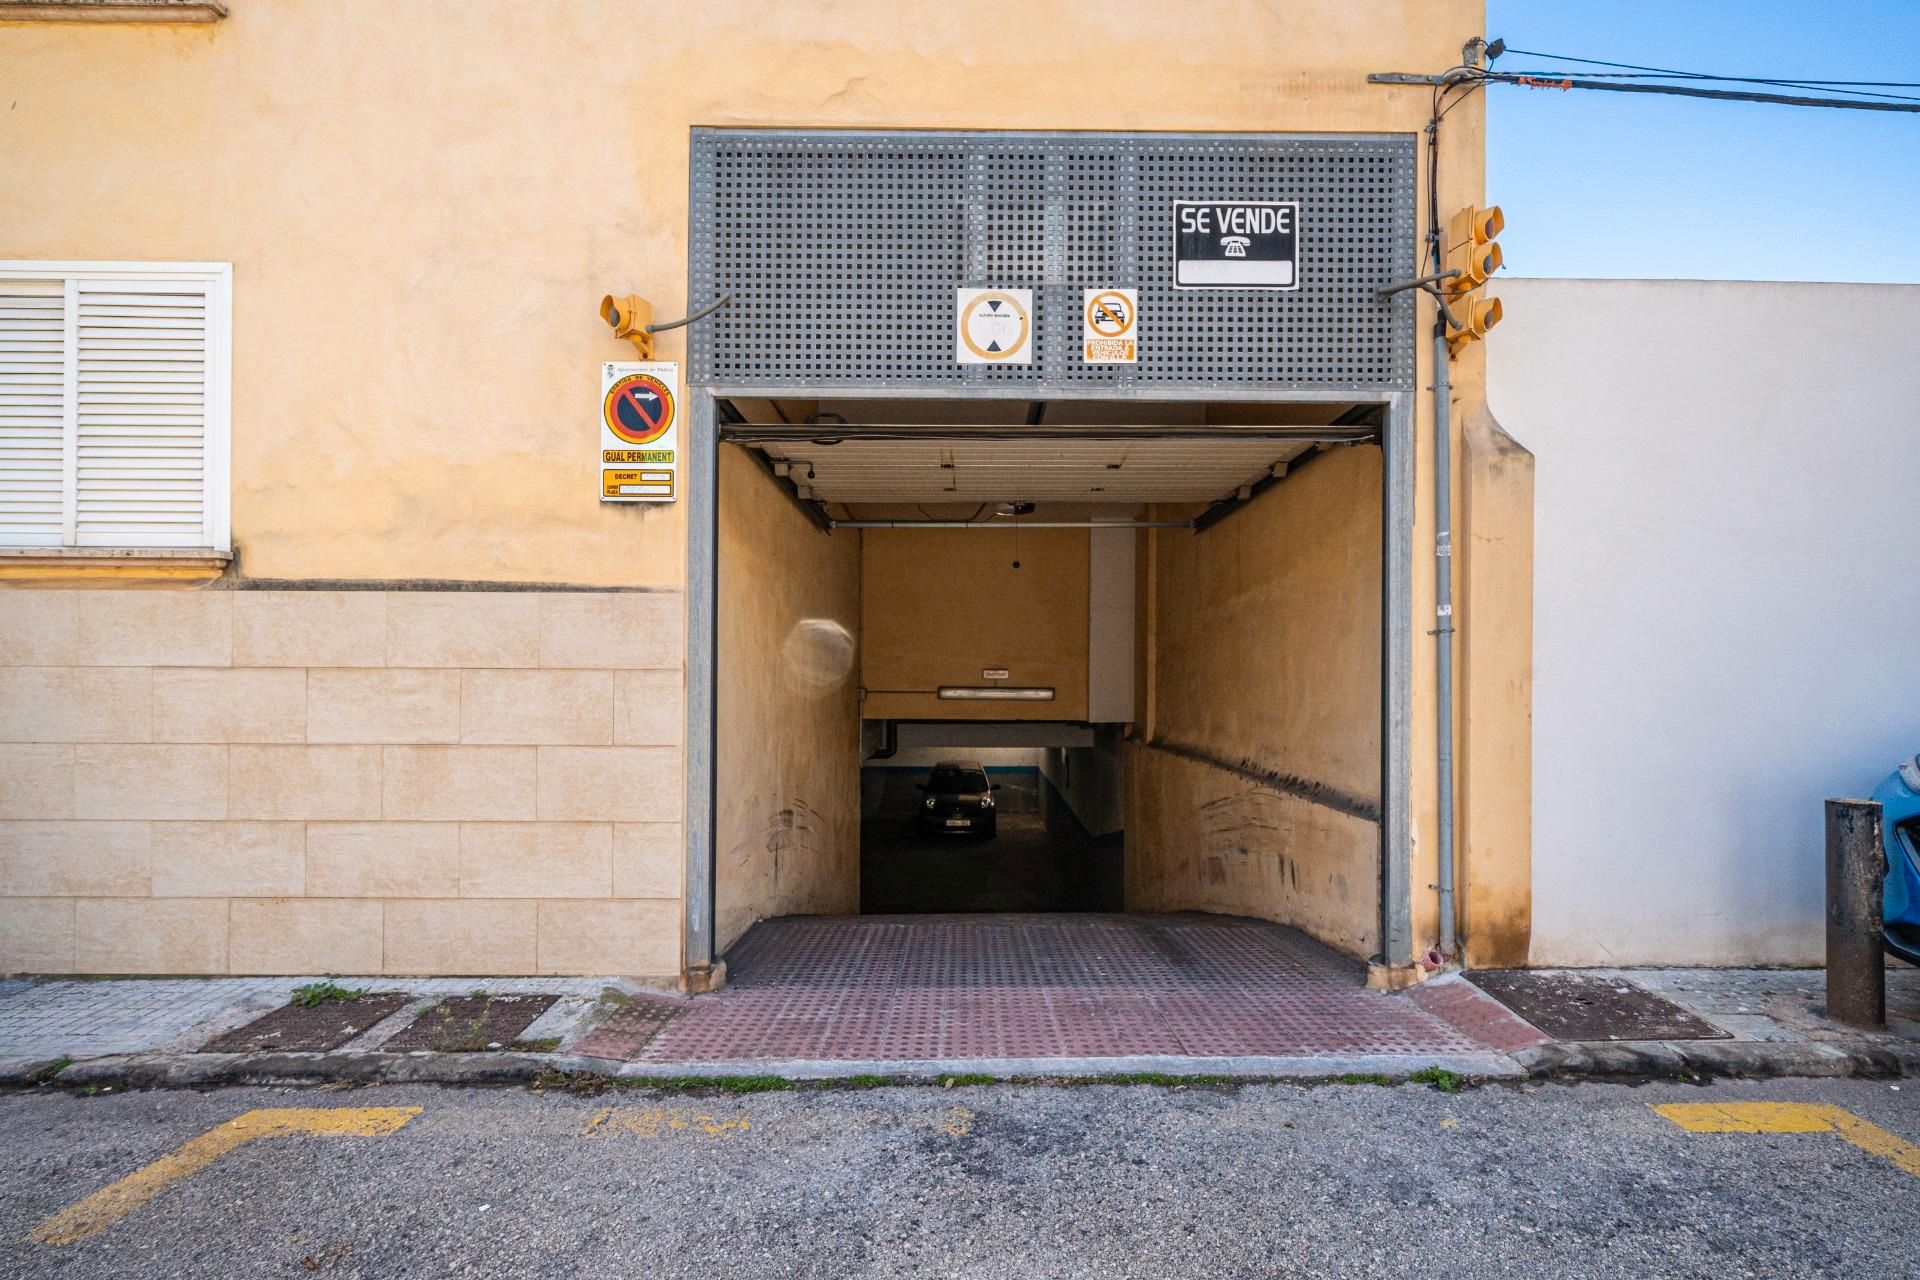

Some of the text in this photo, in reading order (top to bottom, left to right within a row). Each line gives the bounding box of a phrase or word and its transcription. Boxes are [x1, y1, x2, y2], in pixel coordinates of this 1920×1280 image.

[1181, 208, 1290, 234] SE VENDE
[610, 377, 632, 395] SORTIDA
[647, 377, 669, 396] VEHICLES
[605, 452, 672, 462] GUAL PERMANENT
